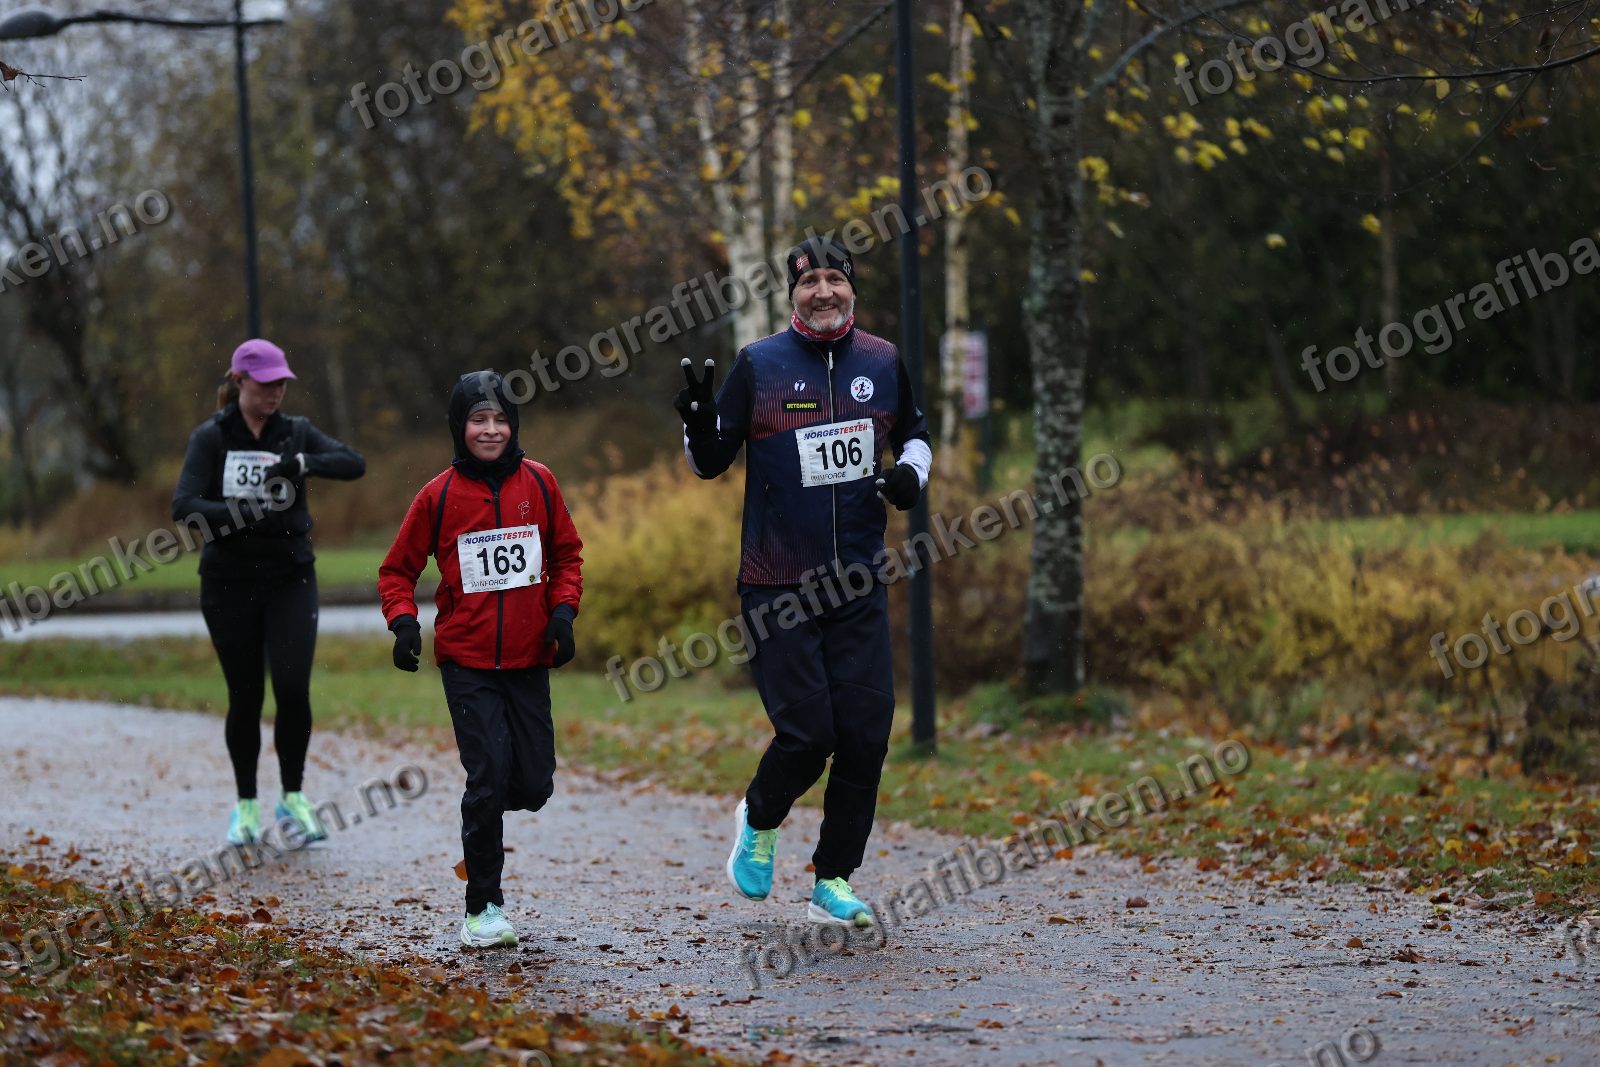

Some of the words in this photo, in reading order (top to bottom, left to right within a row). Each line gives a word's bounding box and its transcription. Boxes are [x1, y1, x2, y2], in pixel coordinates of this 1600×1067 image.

[816, 437, 862, 470] 106
[236, 464, 272, 487] 35
[464, 530, 534, 545] NORGESTESTEN
[477, 543, 527, 576] 163
